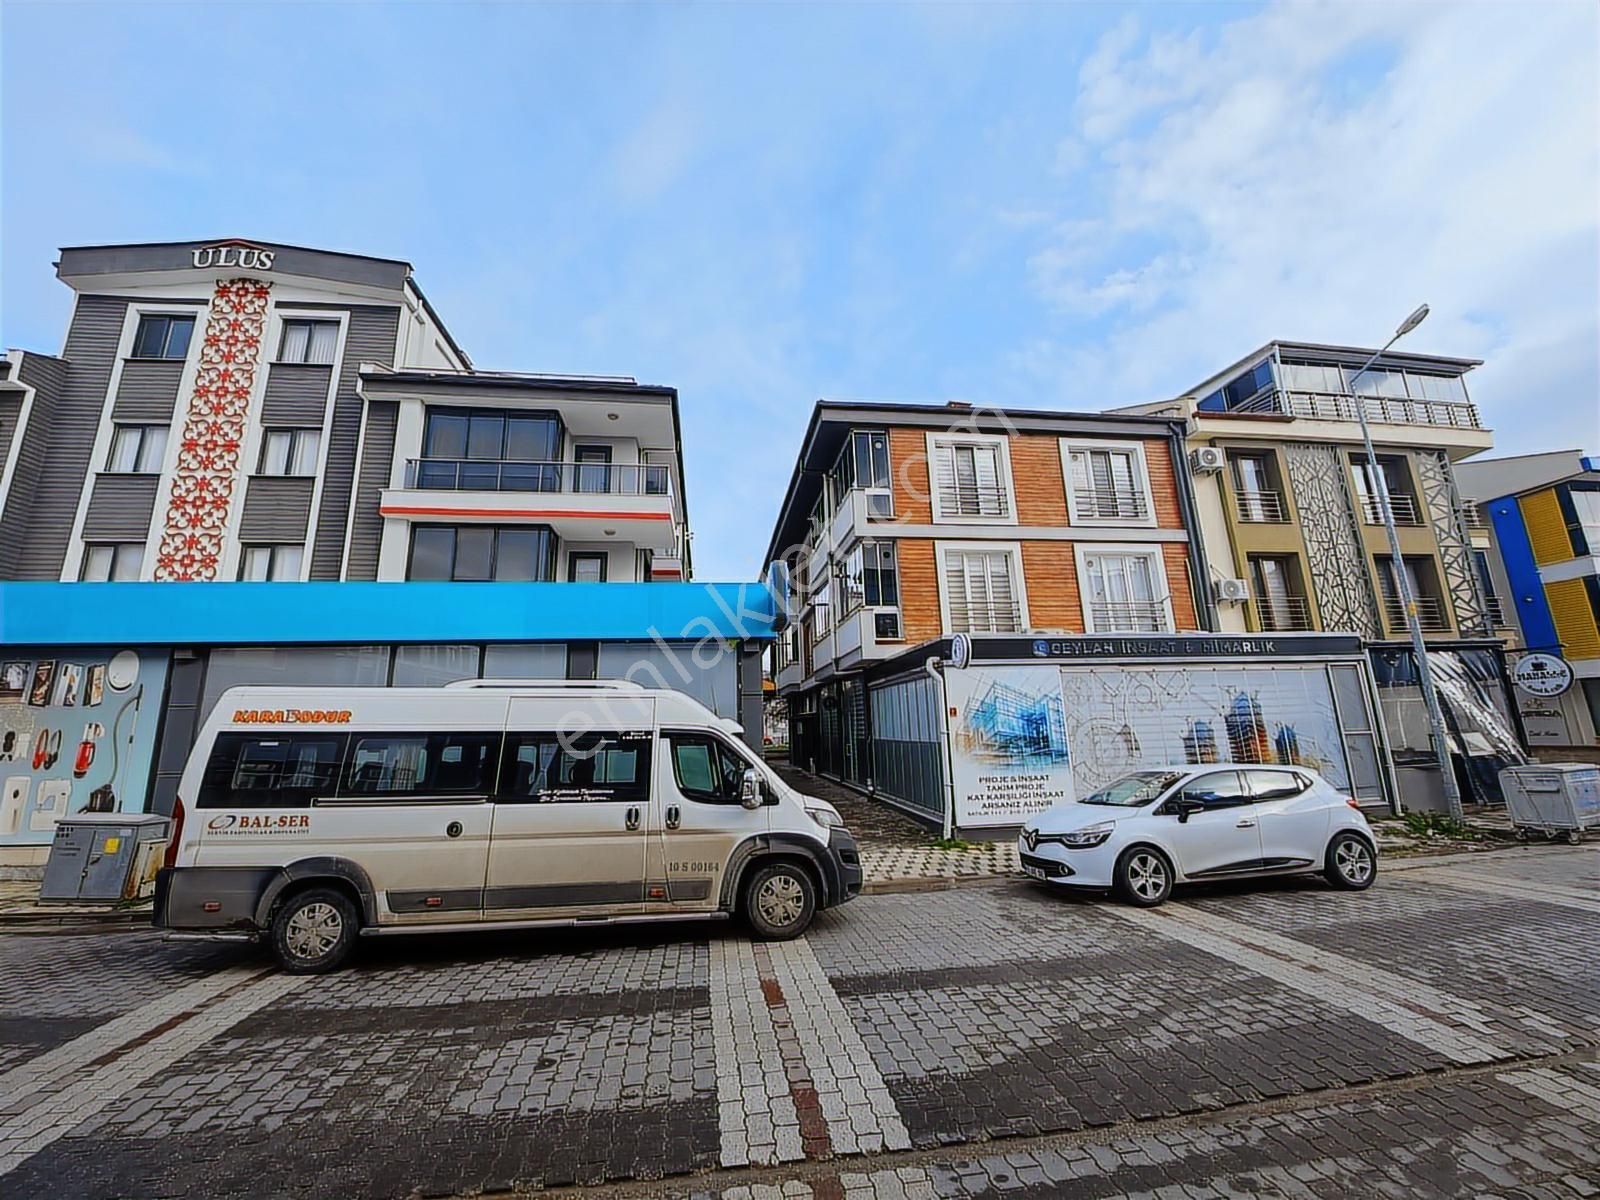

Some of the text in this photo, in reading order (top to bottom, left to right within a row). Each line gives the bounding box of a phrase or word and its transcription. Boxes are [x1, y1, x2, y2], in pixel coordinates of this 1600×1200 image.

[192, 247, 275, 270] ULUS
[239, 815, 310, 828] BAL-SER
[669, 862, 679, 871] 10
[681, 862, 689, 872] S
